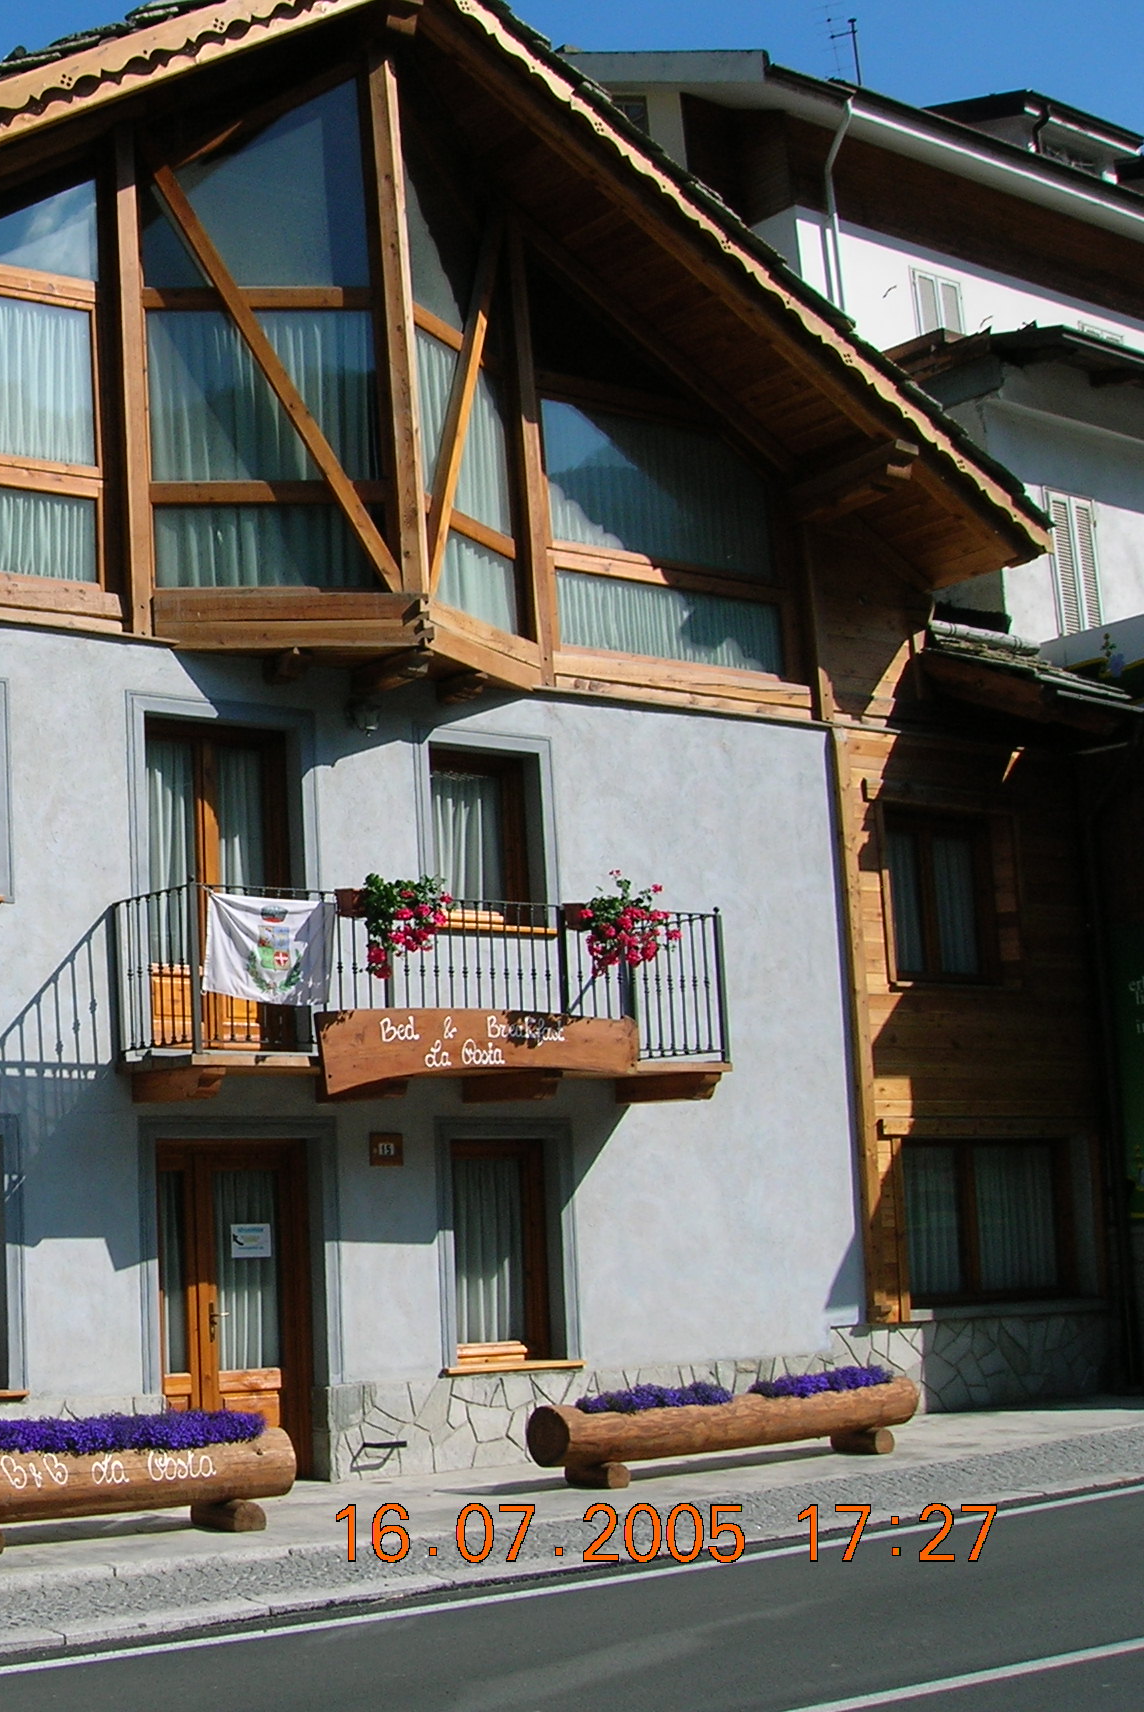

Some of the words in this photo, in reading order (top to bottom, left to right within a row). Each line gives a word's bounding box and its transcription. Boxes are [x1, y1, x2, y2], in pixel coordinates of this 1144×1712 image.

[379, 1014, 420, 1043] Bed
[443, 1017, 458, 1040] &
[486, 1014, 566, 1047] Breakfast
[424, 1039, 452, 1068] La
